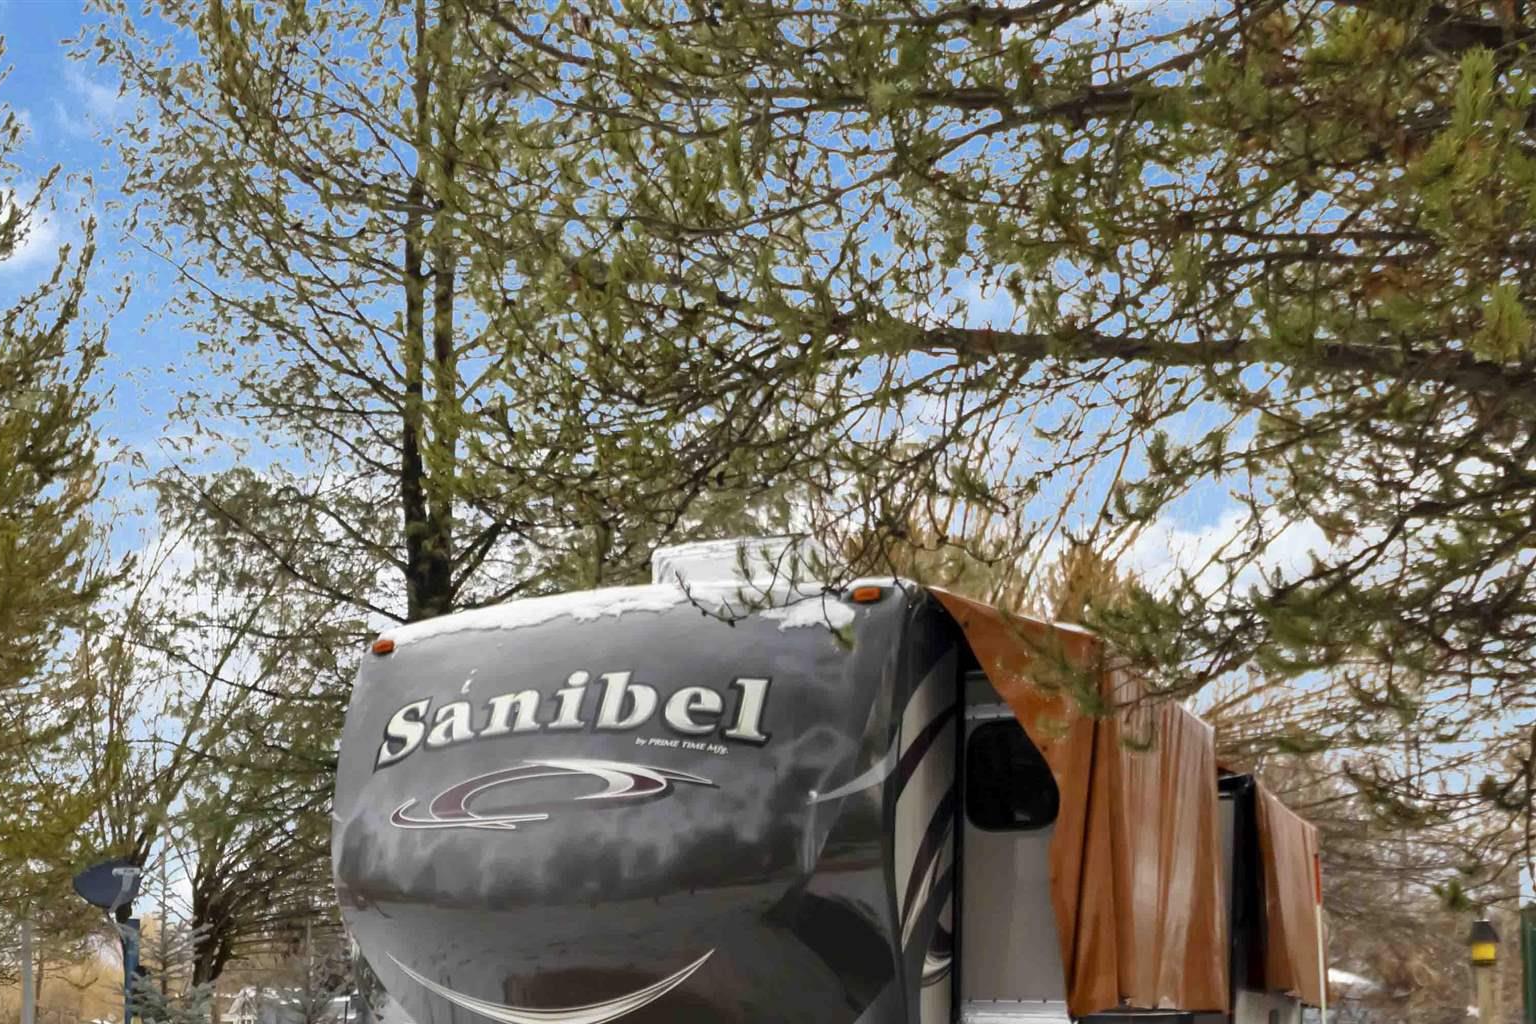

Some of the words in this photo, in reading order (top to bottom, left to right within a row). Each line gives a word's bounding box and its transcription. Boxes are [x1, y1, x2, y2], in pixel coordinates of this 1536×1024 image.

[374, 669, 771, 771] Sanibel
[635, 737, 646, 746] by
[648, 737, 680, 748] PRIME
[682, 741, 706, 751] TIME
